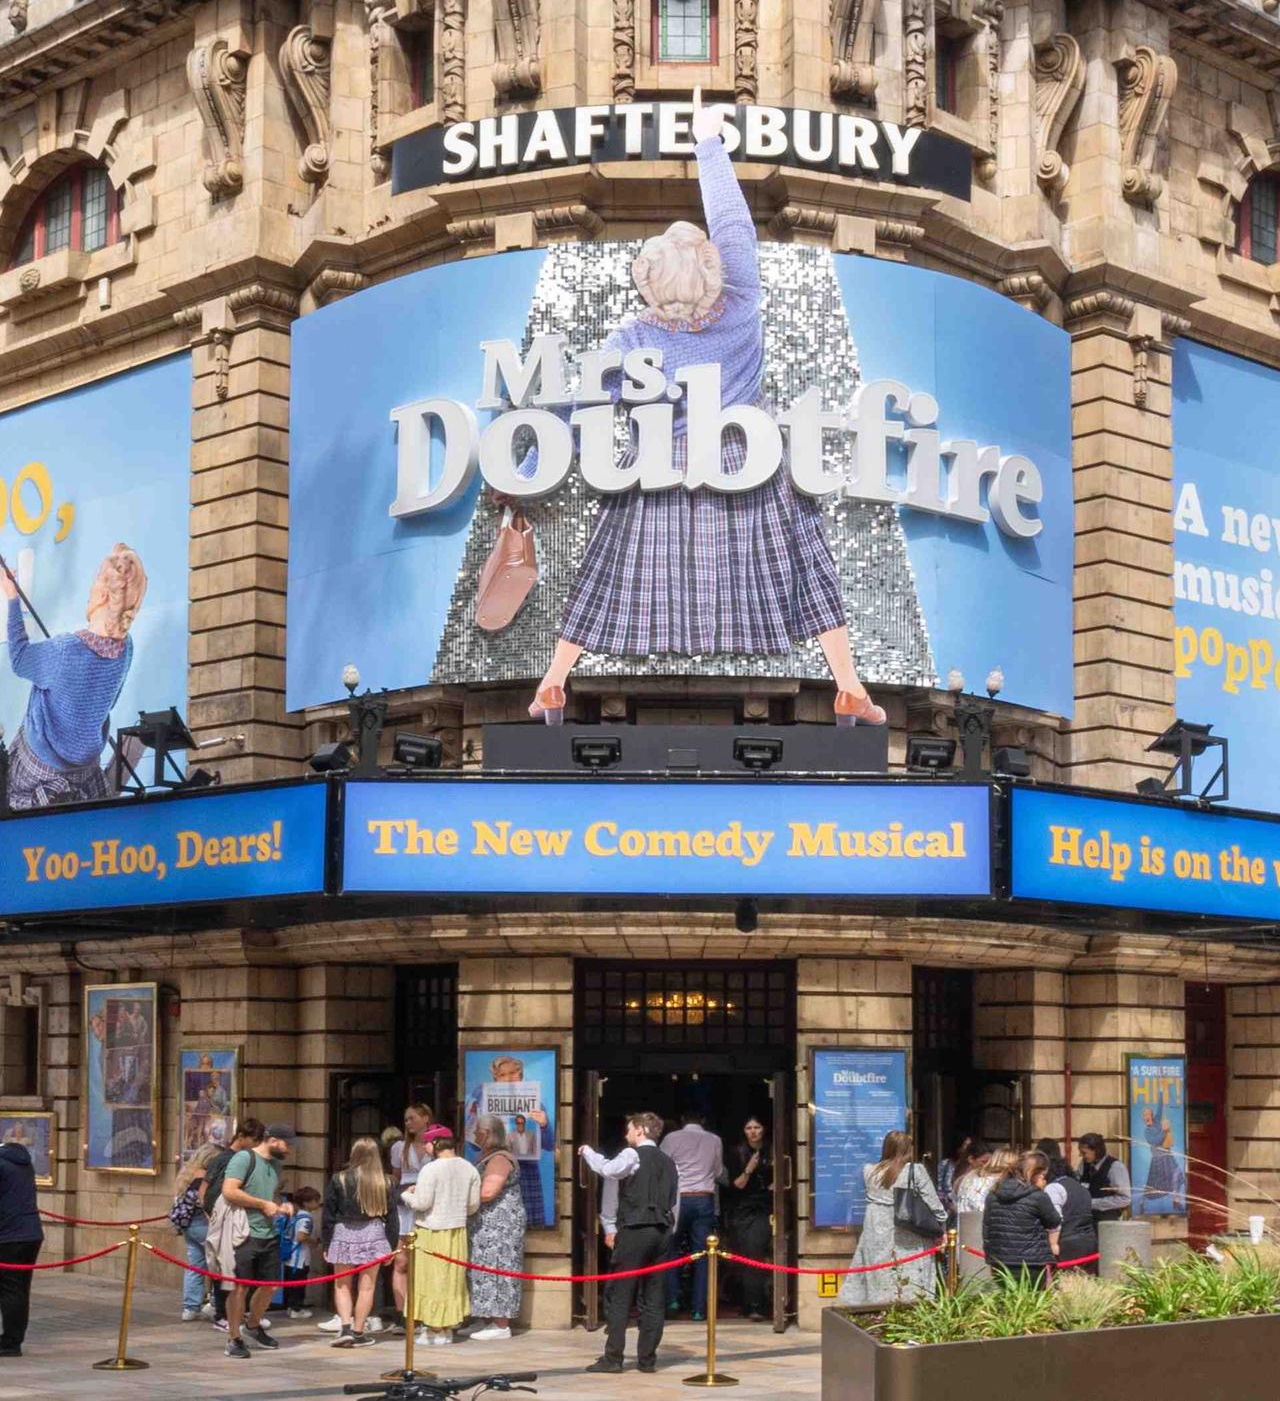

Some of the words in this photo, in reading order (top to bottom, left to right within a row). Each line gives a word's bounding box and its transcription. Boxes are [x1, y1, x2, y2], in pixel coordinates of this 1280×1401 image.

[442, 102, 921, 175] SHAFTESBURY
[479, 333, 683, 409] Mrs.
[389, 364, 1043, 538] Doubtfire
[1174, 482, 1209, 537] A
[23, 838, 166, 881] Yoo-Hoo,
[176, 820, 282, 870] Dears!
[367, 819, 459, 855] The
[471, 820, 572, 856] New
[584, 821, 774, 867] Comedy
[787, 821, 966, 859] Musical
[1049, 825, 1132, 881] Help
[1140, 836, 1165, 875] is
[1174, 850, 1212, 880] on
[1220, 844, 1266, 884] the
[487, 1098, 536, 1112] BRILLIANT
[833, 1072, 887, 1084] Doubtfire
[1133, 1077, 1182, 1105] HIT!
[822, 1272, 838, 1294] H
